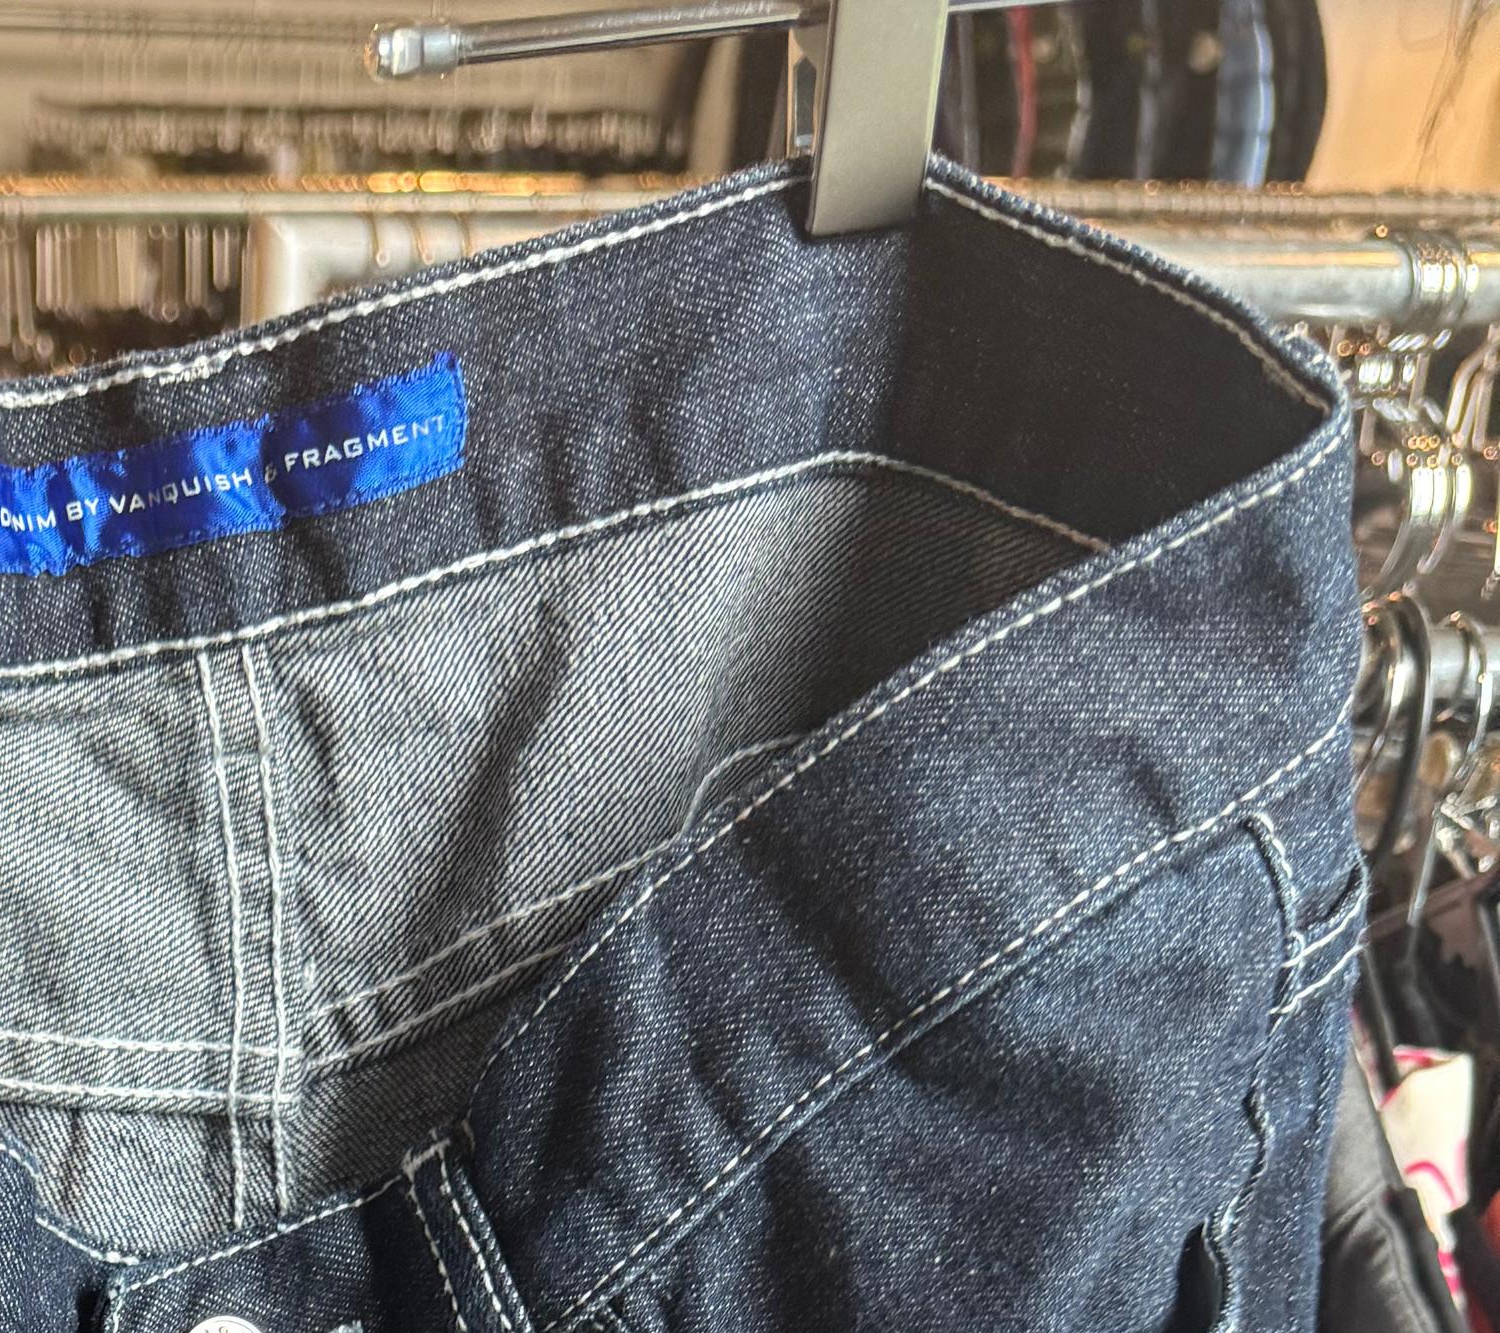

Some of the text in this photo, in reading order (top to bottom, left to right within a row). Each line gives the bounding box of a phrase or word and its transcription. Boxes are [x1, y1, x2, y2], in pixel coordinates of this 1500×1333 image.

[0, 507, 57, 533] DNIM
[65, 497, 99, 521] BY
[109, 467, 253, 514] VANQUISH
[284, 414, 445, 473] FRAGMENT
